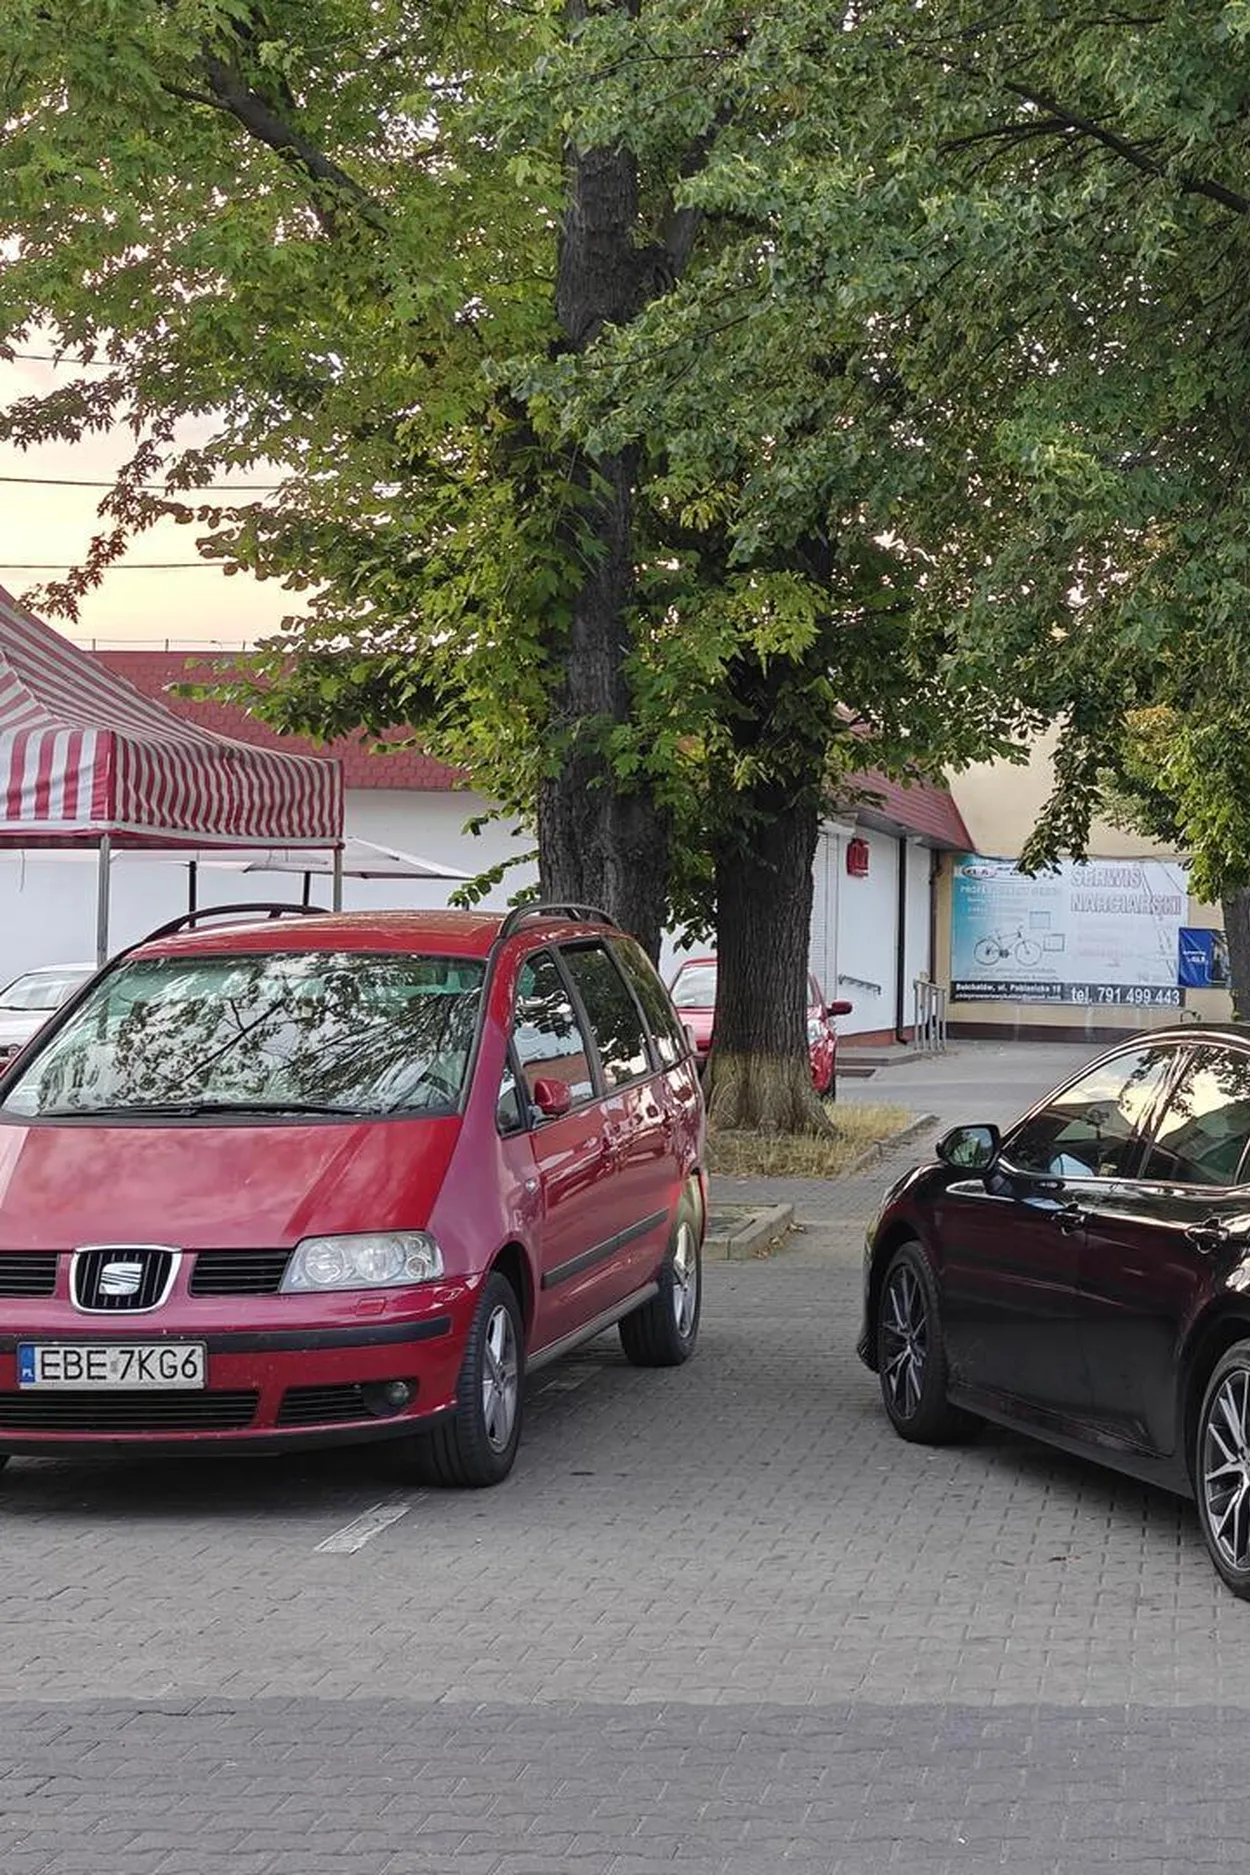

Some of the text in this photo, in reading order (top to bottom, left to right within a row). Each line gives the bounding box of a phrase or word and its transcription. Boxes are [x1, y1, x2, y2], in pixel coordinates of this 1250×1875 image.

[1070, 867, 1143, 889] SERWIS
[1070, 893, 1182, 916] NARCIARSKI
[1071, 985, 1093, 1002] tel.
[1097, 986, 1121, 1003] 791
[1126, 987, 1152, 1004] 499
[1155, 989, 1181, 1006] 443
[40, 1349, 198, 1381] EBE 7KG6
